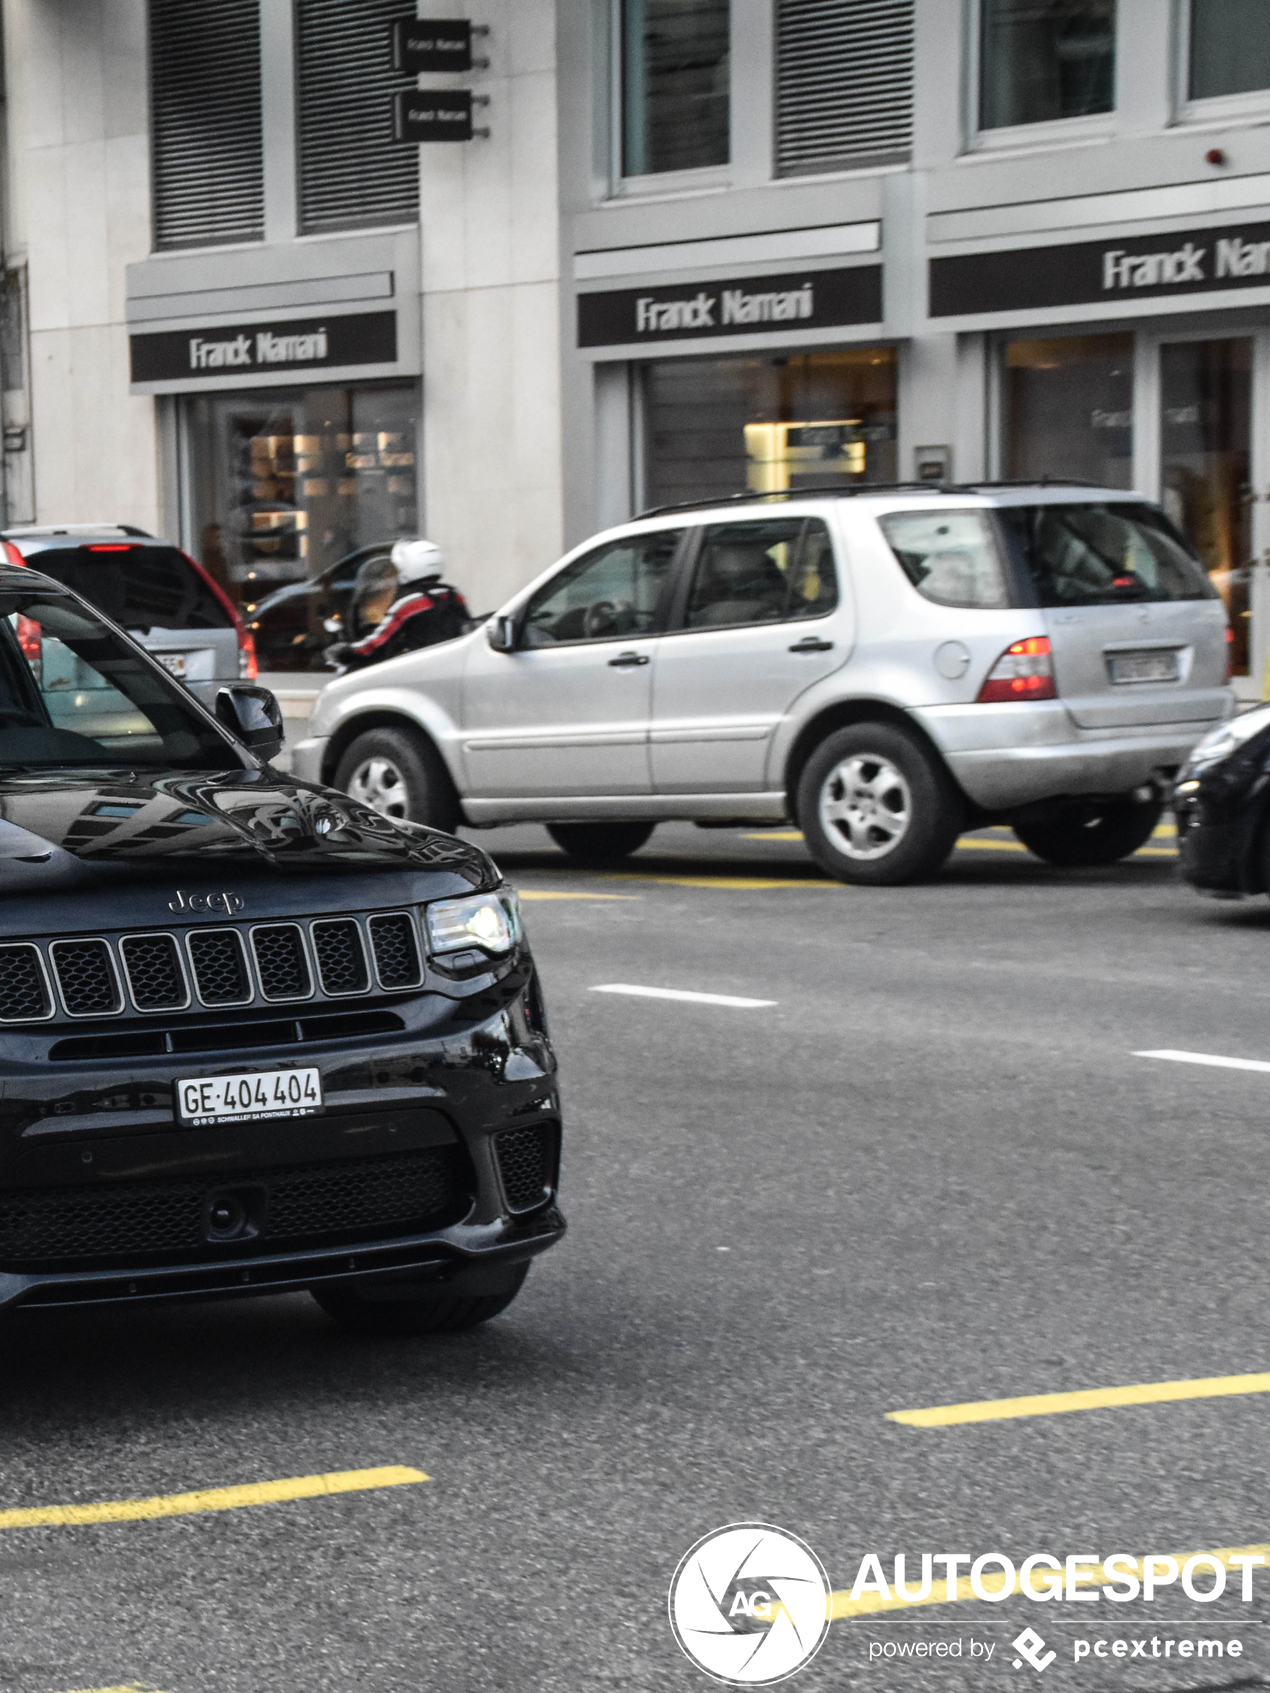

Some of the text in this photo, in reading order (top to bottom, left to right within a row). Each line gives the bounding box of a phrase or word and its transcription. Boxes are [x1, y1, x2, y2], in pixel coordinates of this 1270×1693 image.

[1103, 242, 1207, 289] Franck
[636, 282, 814, 332] Franck Namani
[189, 327, 329, 370] Franck Namani
[168, 890, 245, 916] Jeep
